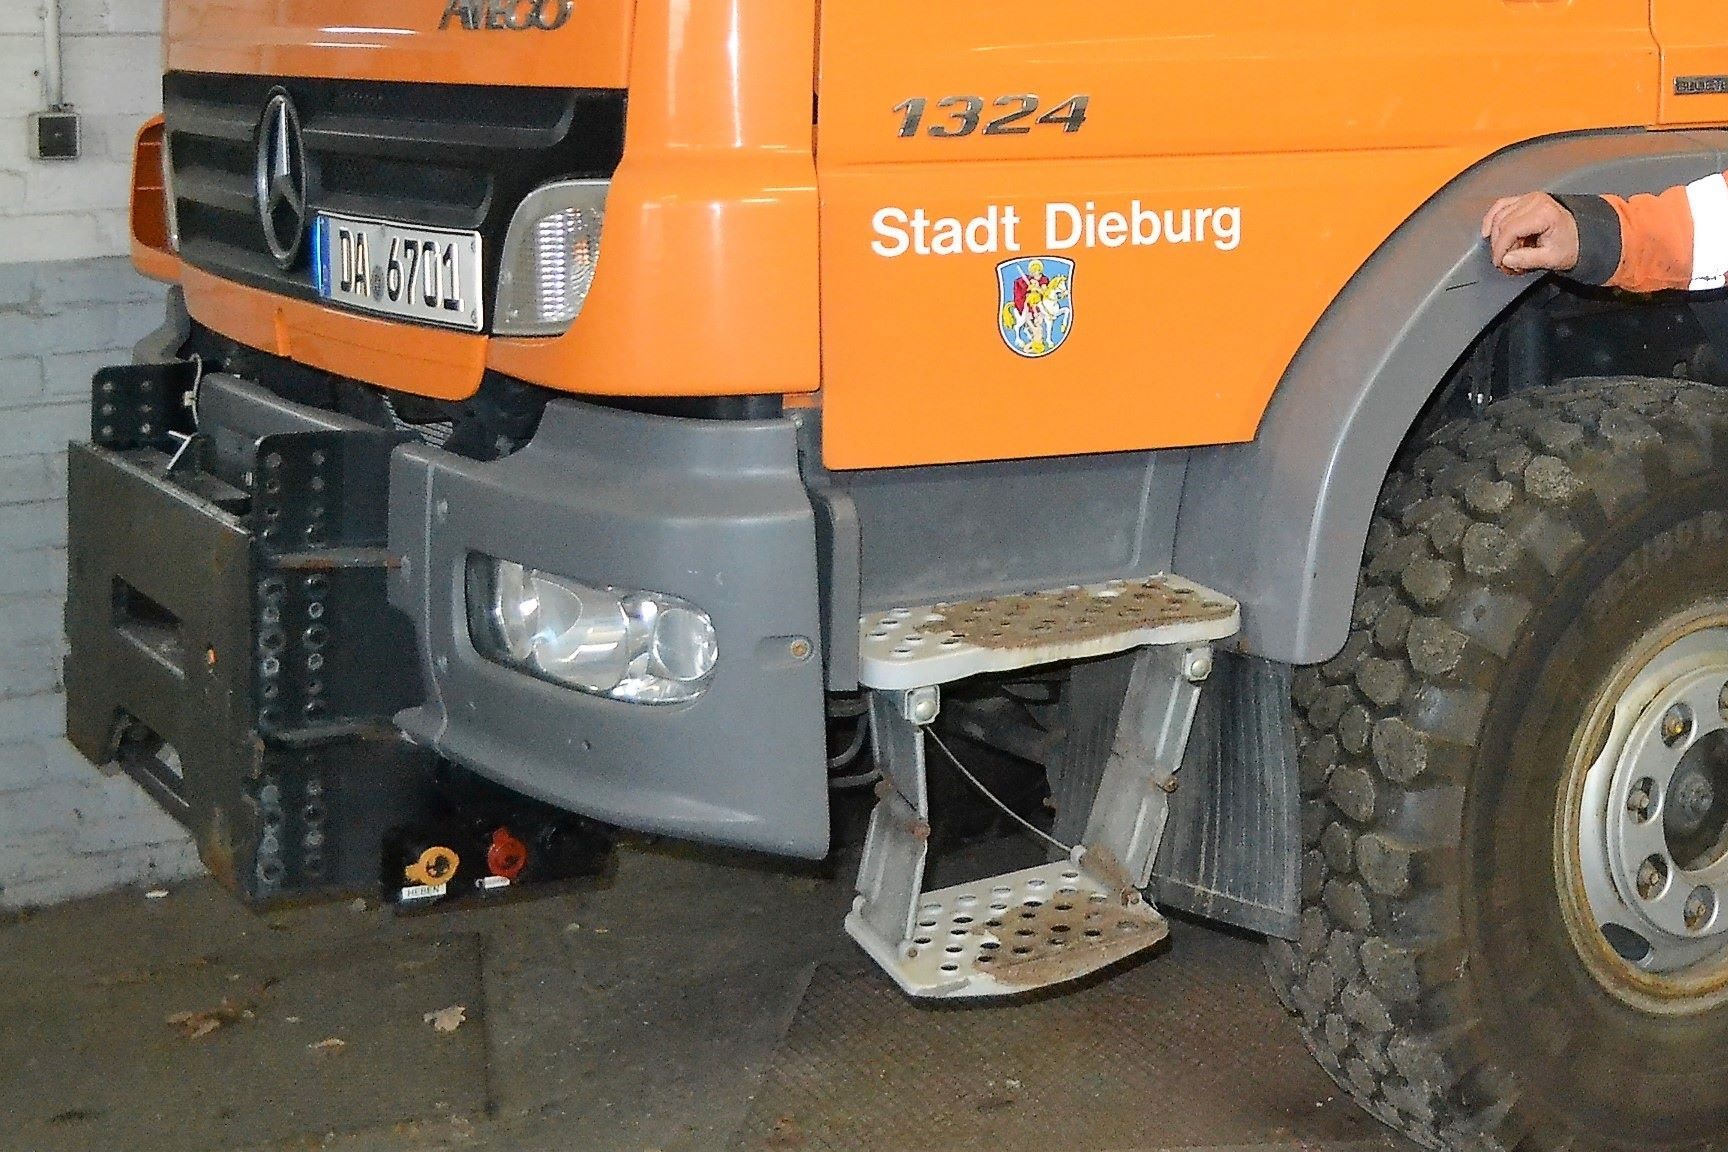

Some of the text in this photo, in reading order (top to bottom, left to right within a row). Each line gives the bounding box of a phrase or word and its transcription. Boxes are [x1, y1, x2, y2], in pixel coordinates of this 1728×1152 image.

[892, 93, 1091, 139] 1324
[870, 199, 1242, 258] Stadt Dieburg
[339, 226, 465, 313] DA 6701
